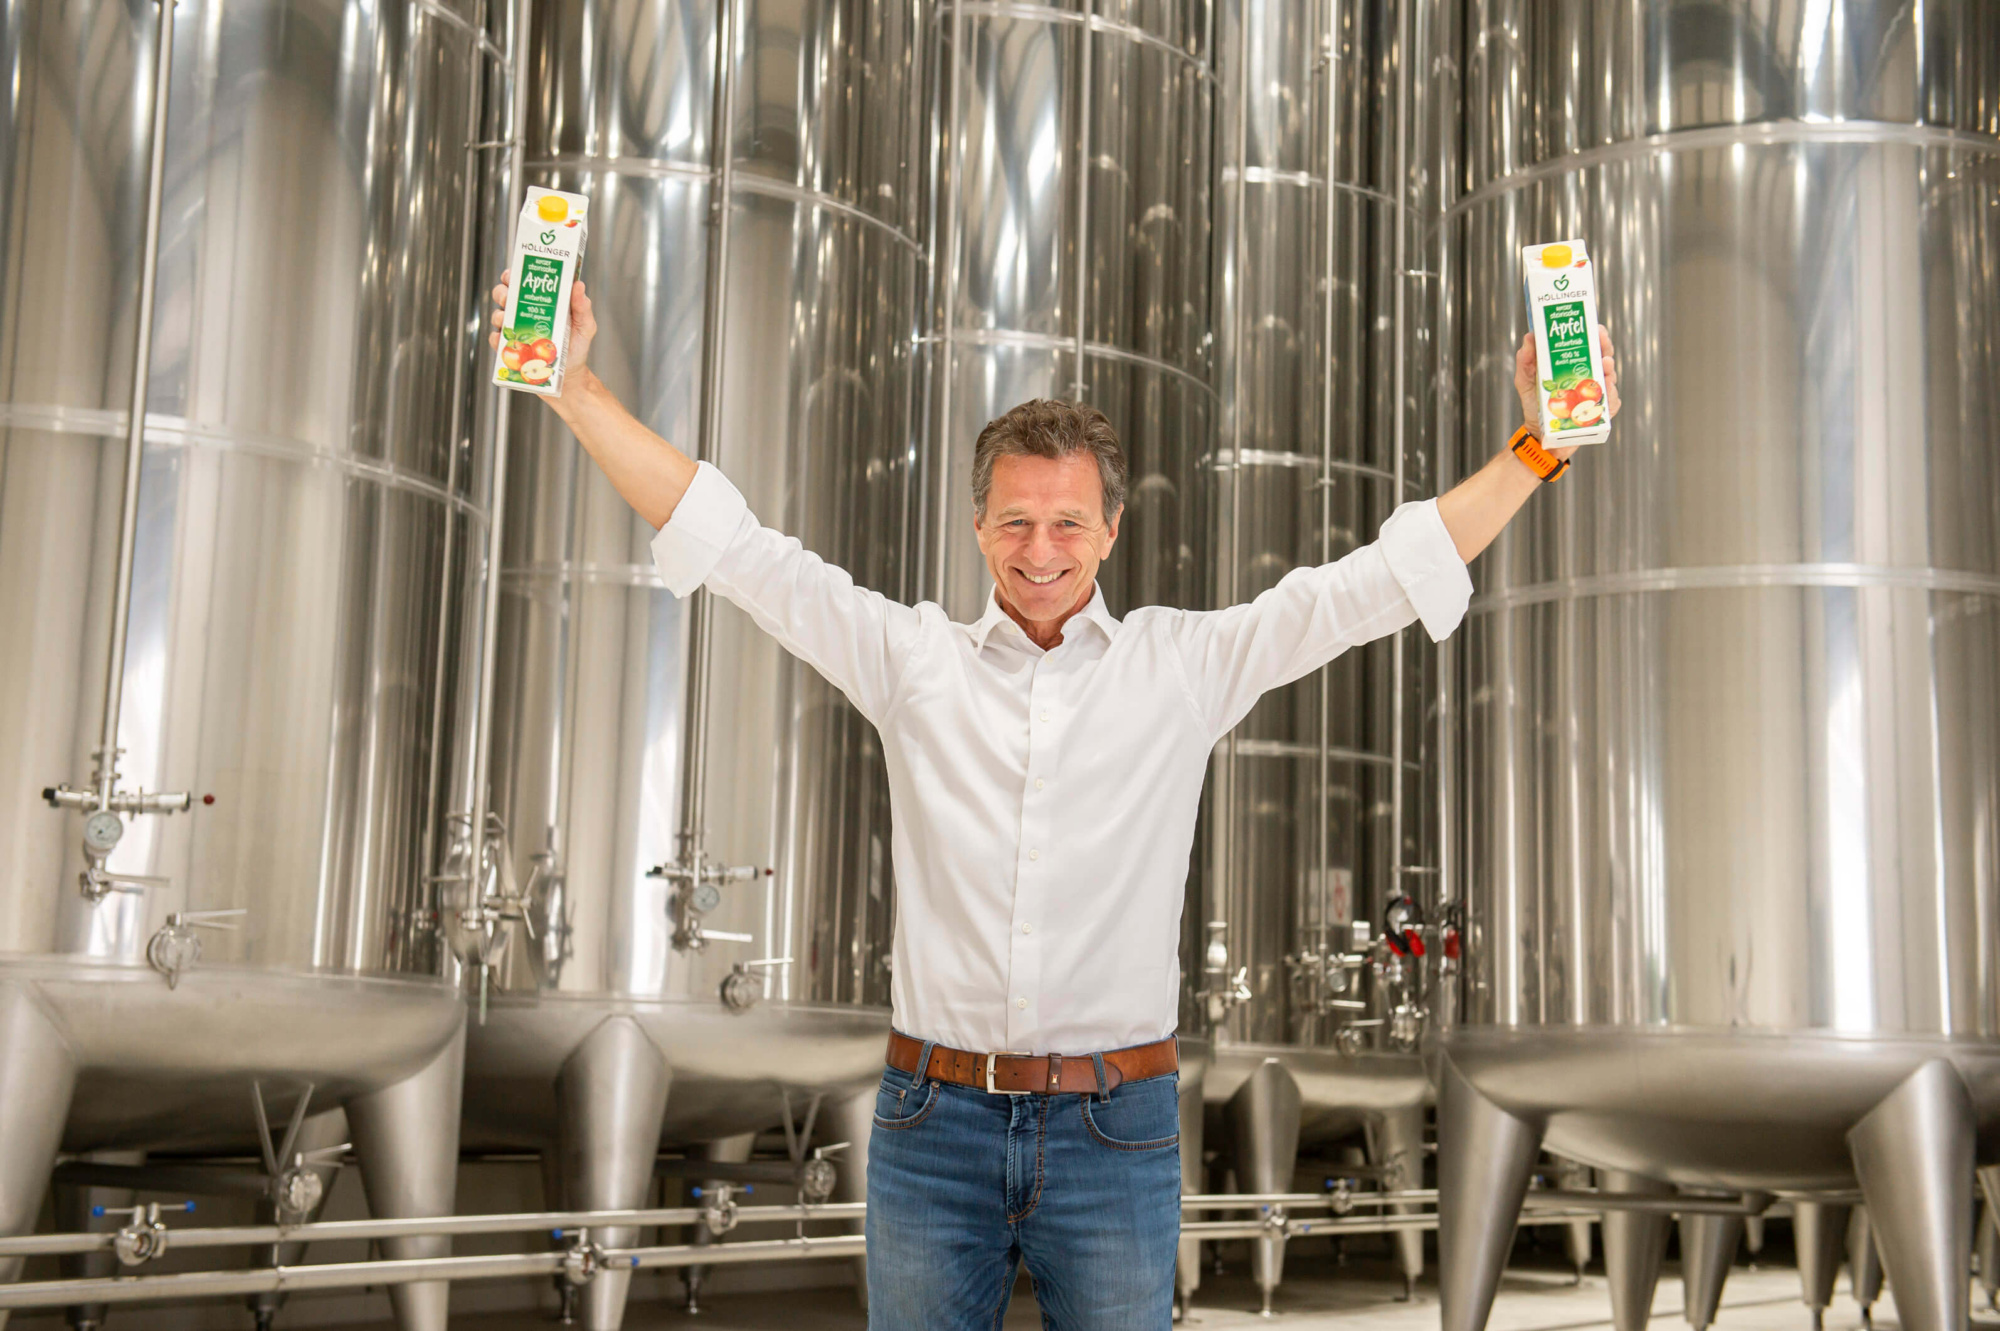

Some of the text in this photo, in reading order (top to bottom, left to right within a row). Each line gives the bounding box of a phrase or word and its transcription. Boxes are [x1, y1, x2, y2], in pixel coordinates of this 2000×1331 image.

[522, 271, 559, 293] Apfel
[1549, 316, 1584, 340] Apfel
[1560, 351, 1573, 359] 100
